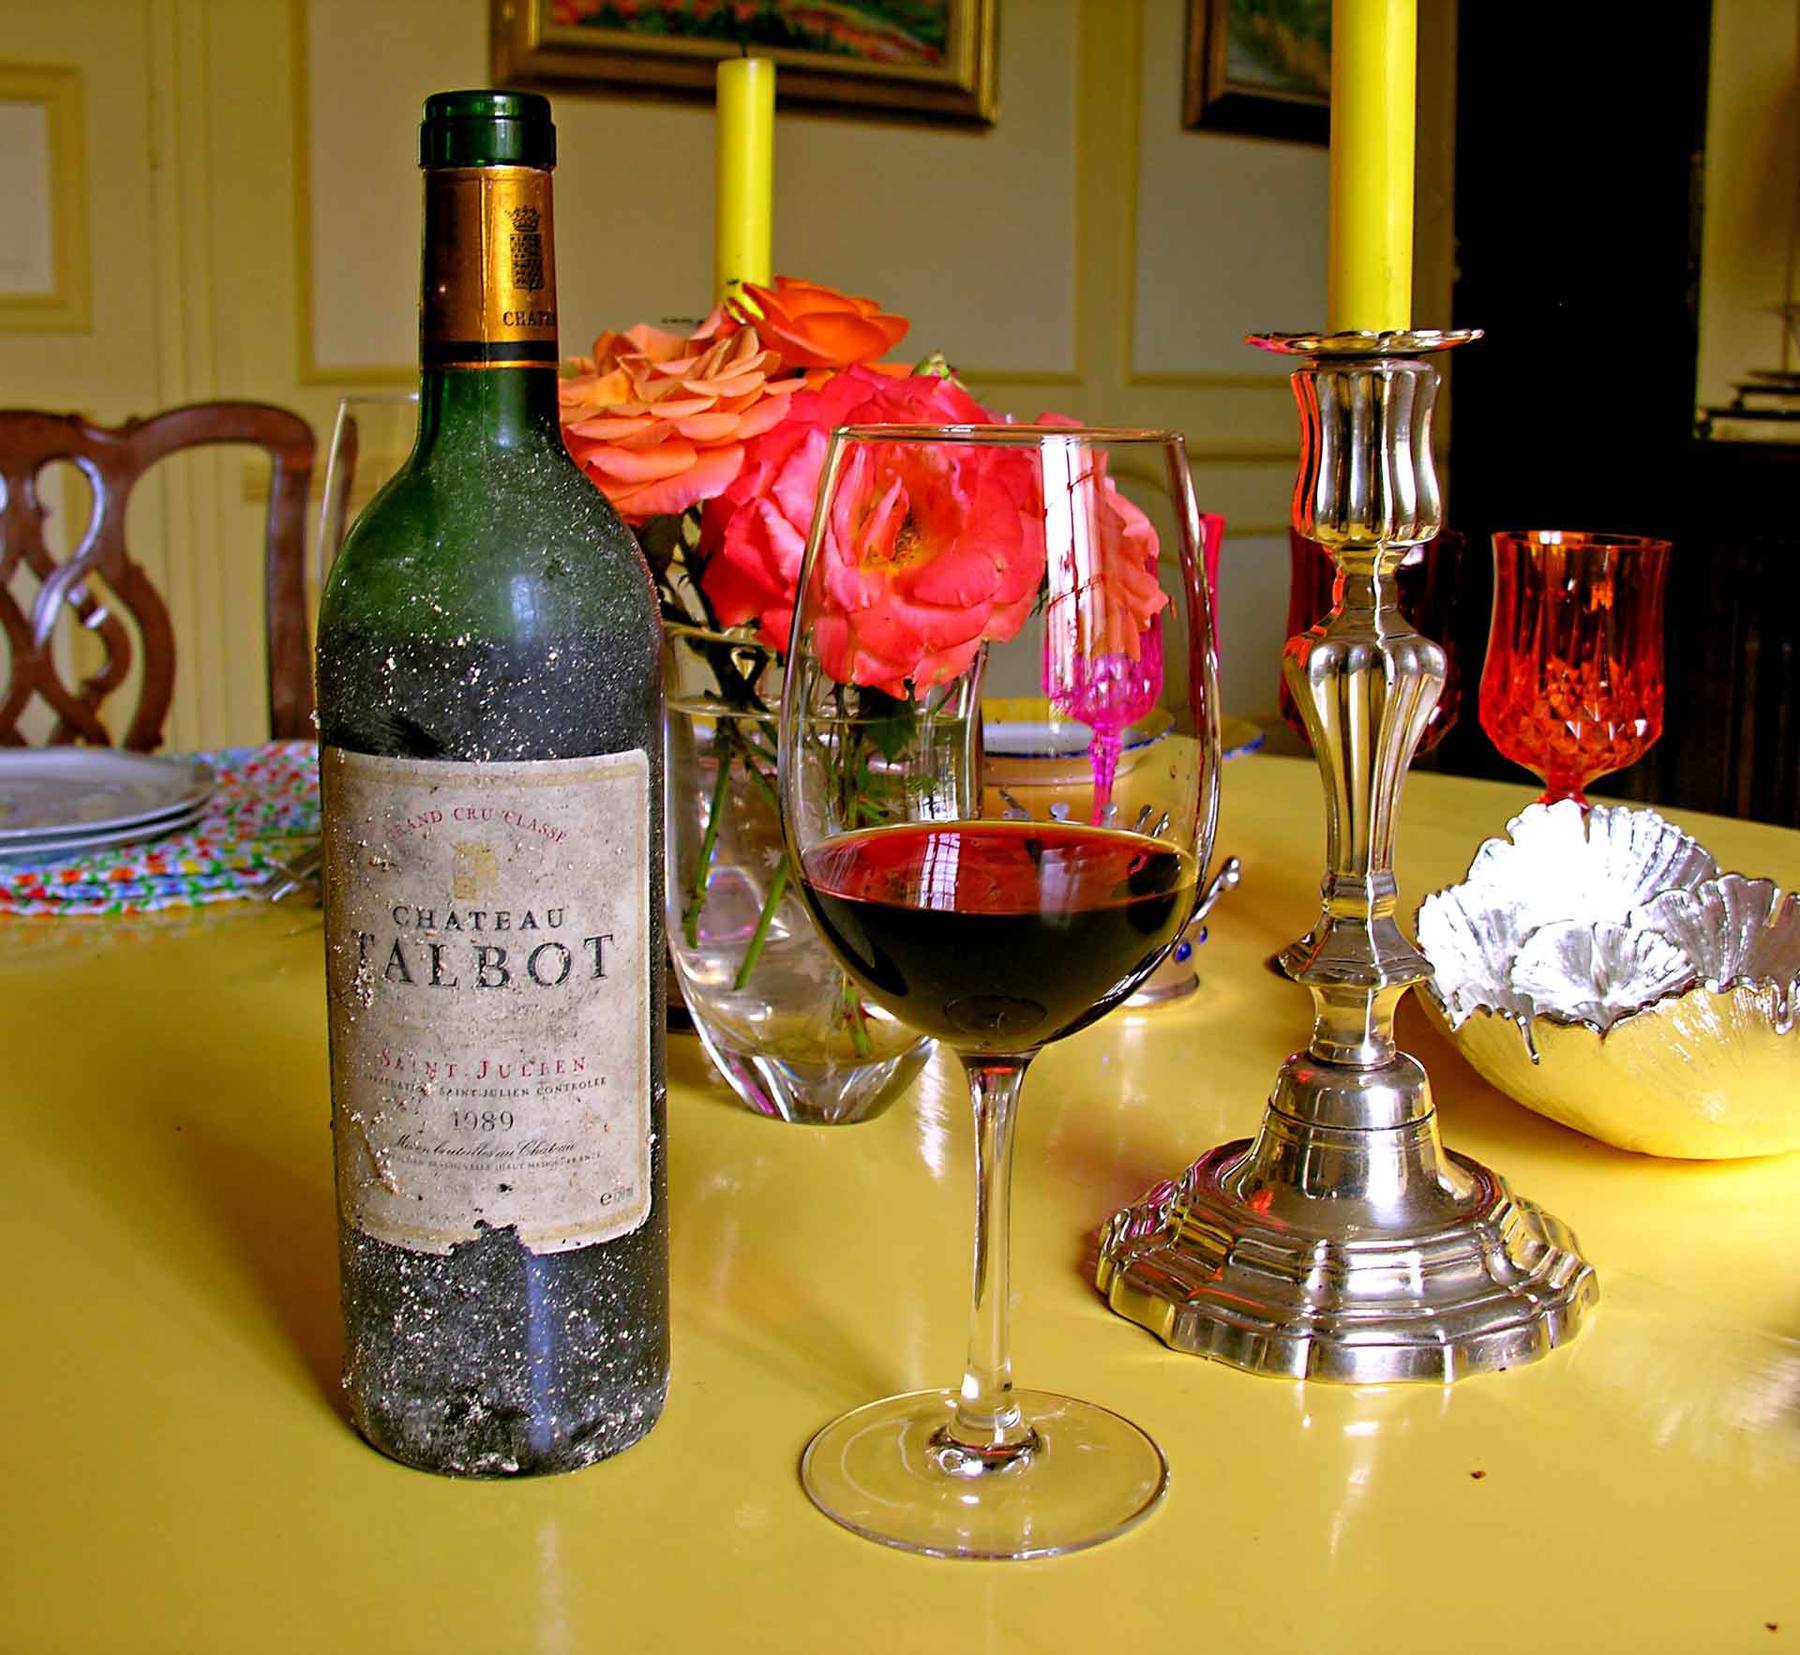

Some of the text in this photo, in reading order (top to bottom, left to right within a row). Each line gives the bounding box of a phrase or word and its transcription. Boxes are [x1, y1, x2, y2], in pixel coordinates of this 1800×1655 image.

[453, 807, 493, 821] CRU
[392, 906, 564, 931] CHATEAU
[352, 930, 614, 989] TALBOT
[452, 1110, 515, 1132] 1989
